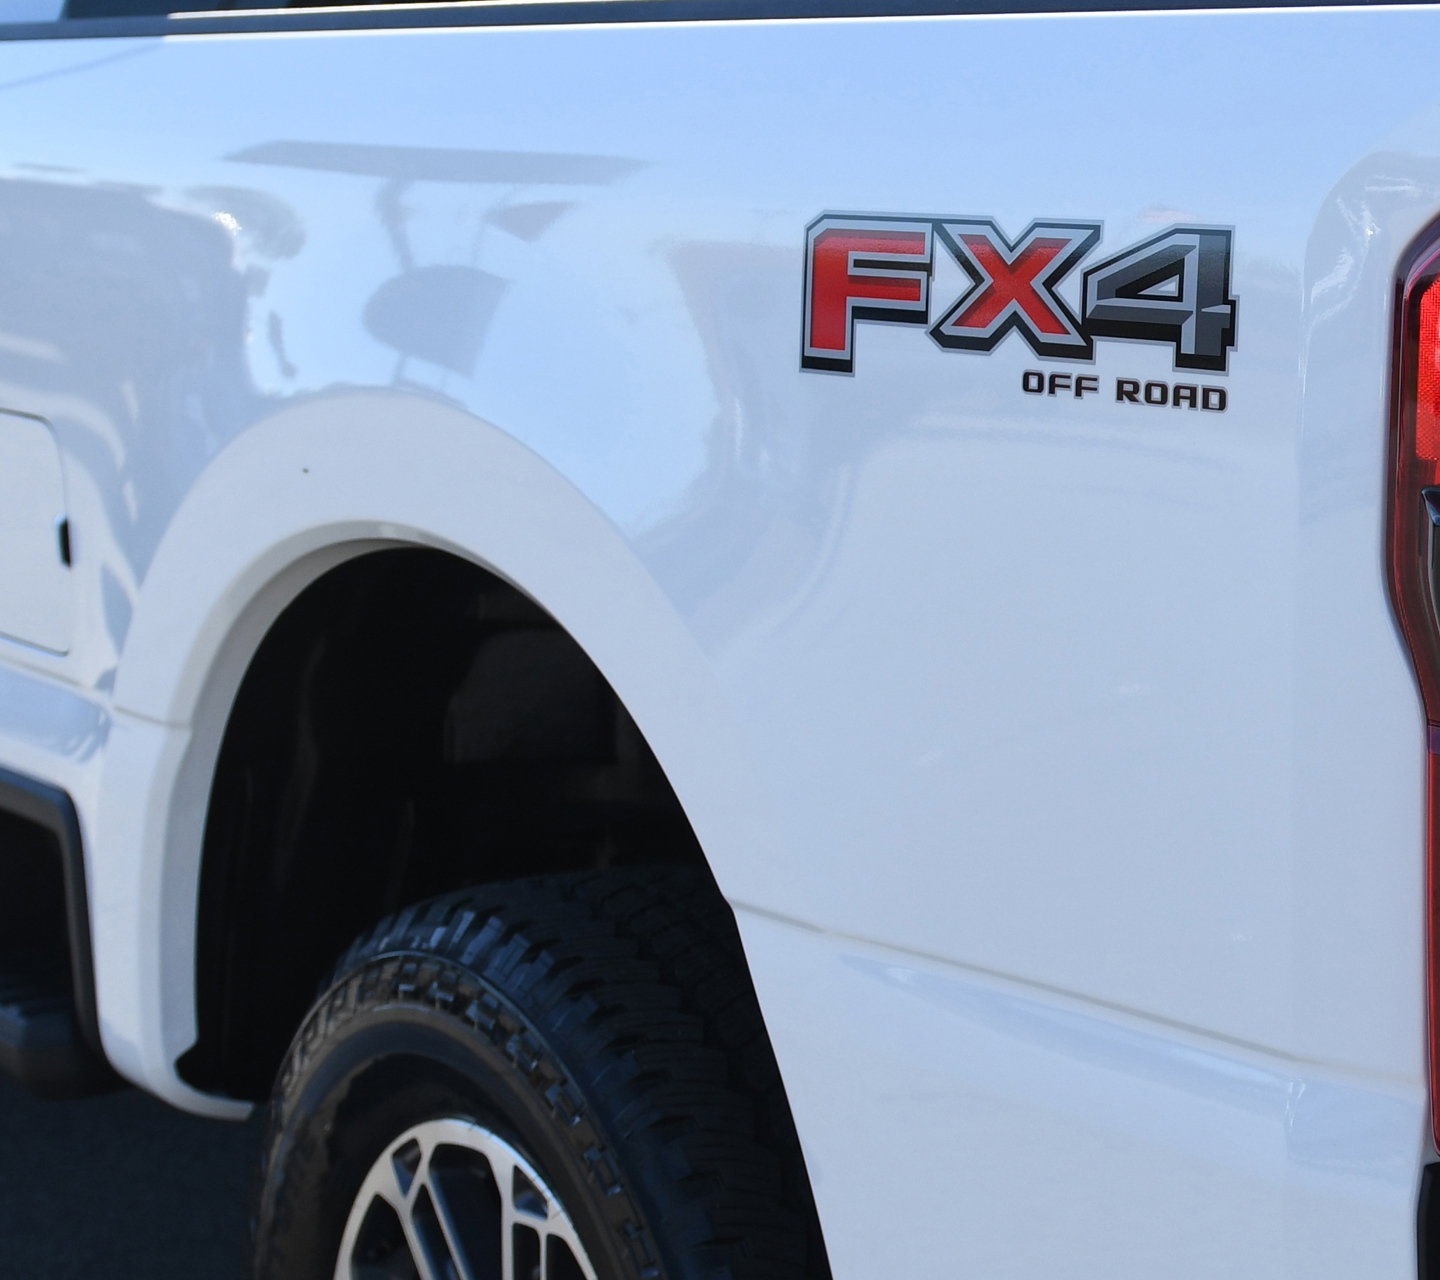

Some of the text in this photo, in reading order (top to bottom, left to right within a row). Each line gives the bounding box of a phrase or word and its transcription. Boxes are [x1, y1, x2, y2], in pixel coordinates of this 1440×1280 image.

[800, 210, 1239, 376] FX4
[1021, 369, 1229, 413] OFF ROAD
